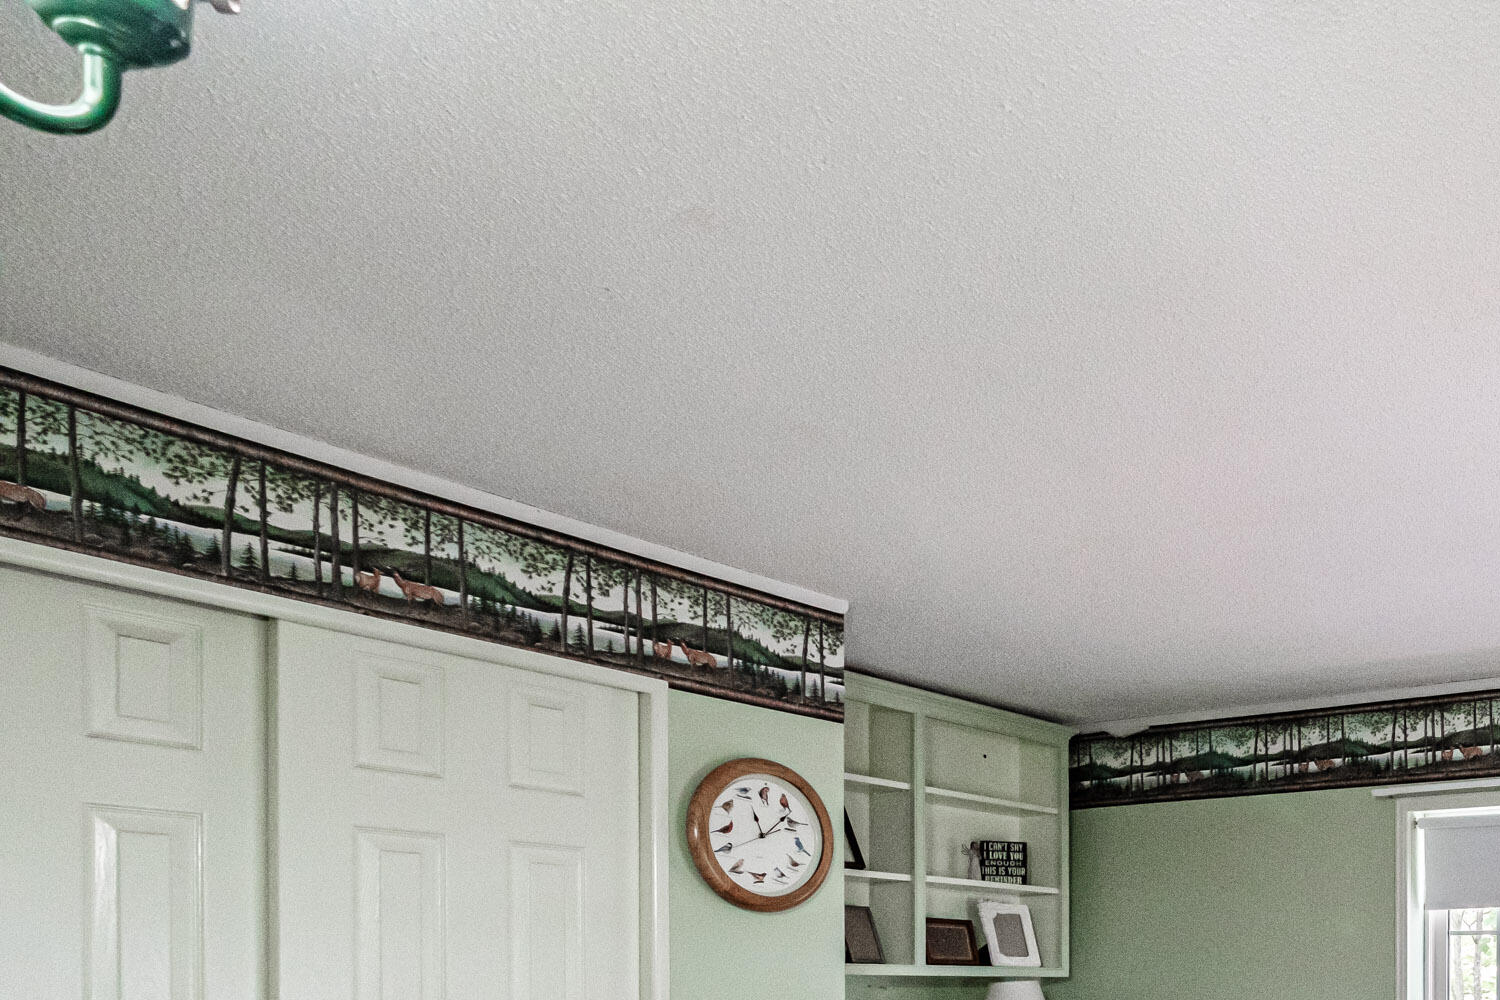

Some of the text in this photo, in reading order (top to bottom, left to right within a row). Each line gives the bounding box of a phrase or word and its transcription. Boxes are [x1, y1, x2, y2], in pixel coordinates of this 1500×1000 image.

[989, 842, 1008, 850] CAN'T
[1010, 843, 1023, 851] SAY
[989, 851, 1007, 860] LOVE
[1010, 852, 1023, 860] YOU
[982, 866, 1026, 876] THIS IS YOUR
